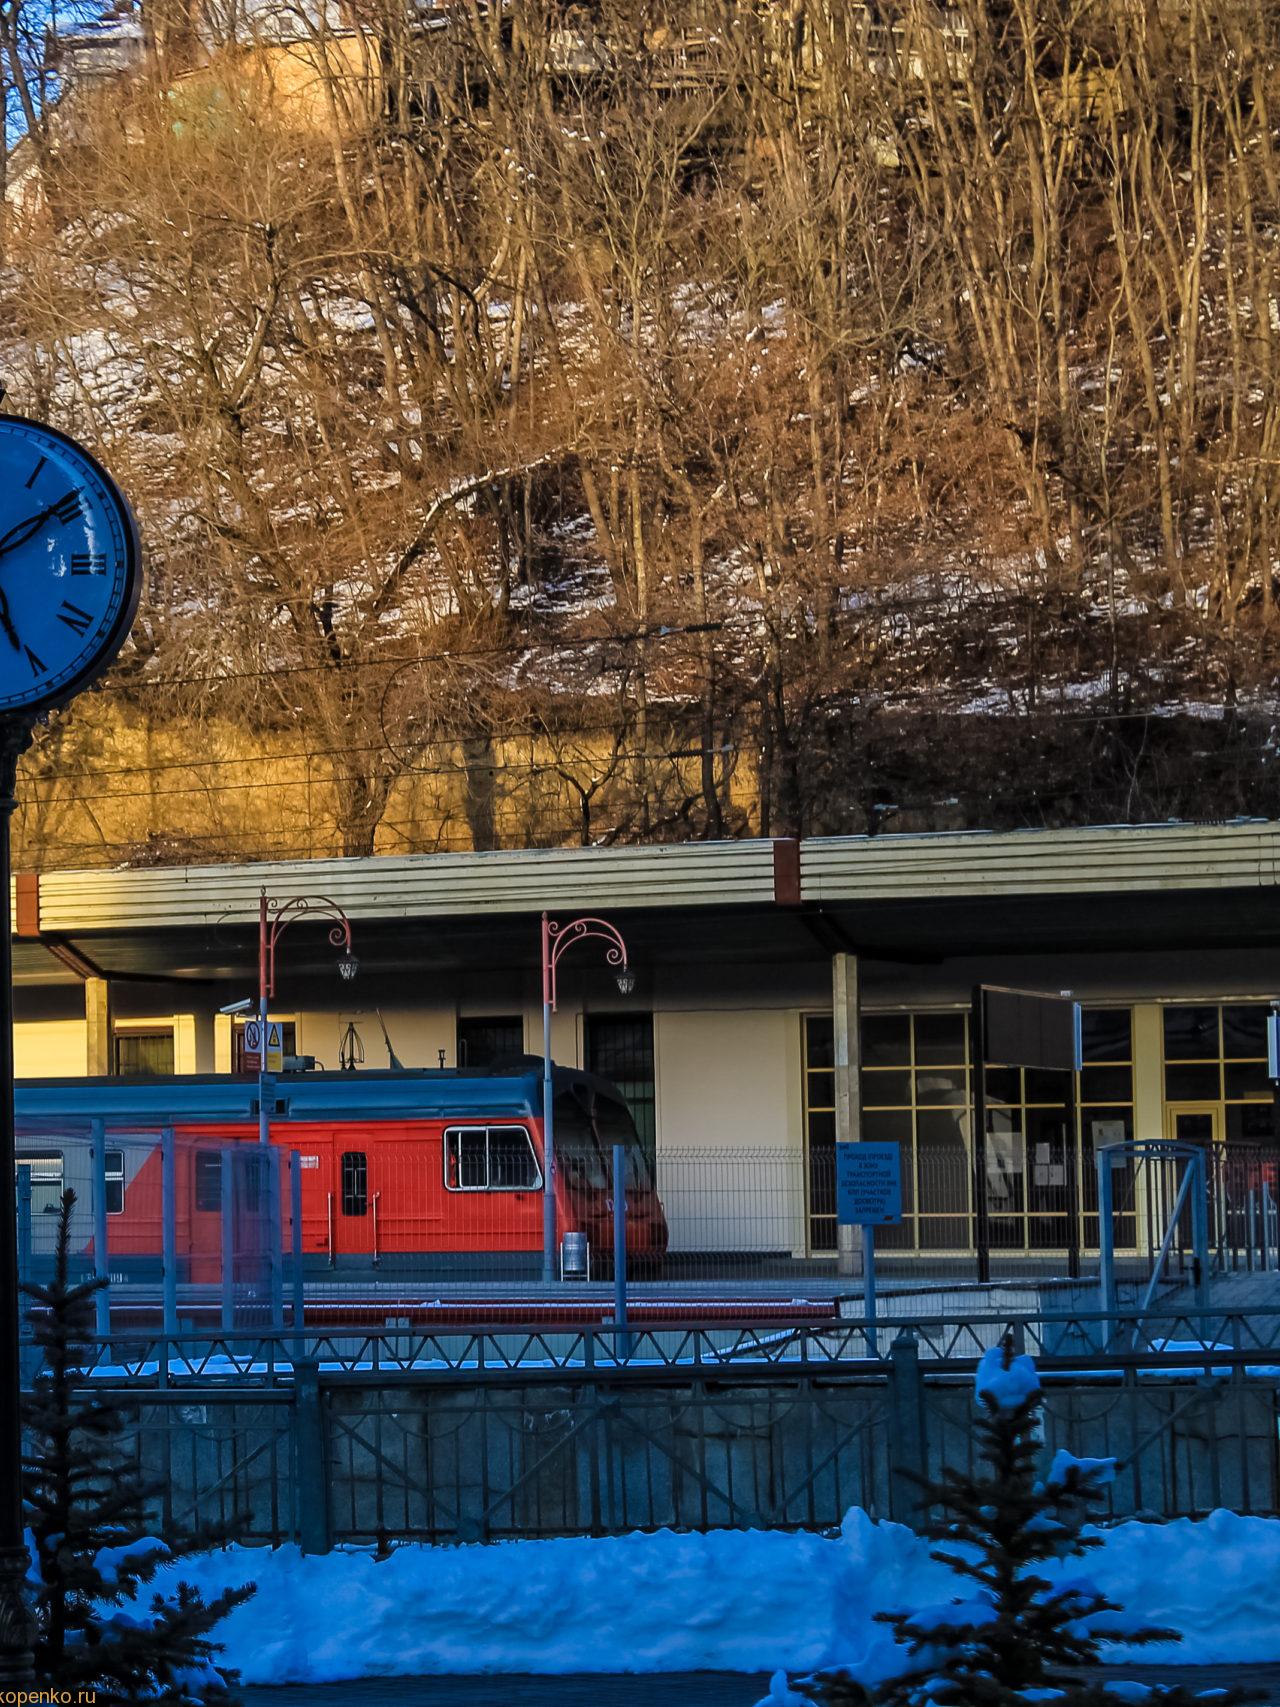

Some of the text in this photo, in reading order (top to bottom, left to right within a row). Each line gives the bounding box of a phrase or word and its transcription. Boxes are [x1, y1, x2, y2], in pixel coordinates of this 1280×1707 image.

[24, 456, 48, 489] I
[71, 553, 107, 576] III
[56, 600, 94, 638] IV
[23, 645, 47, 677] V
